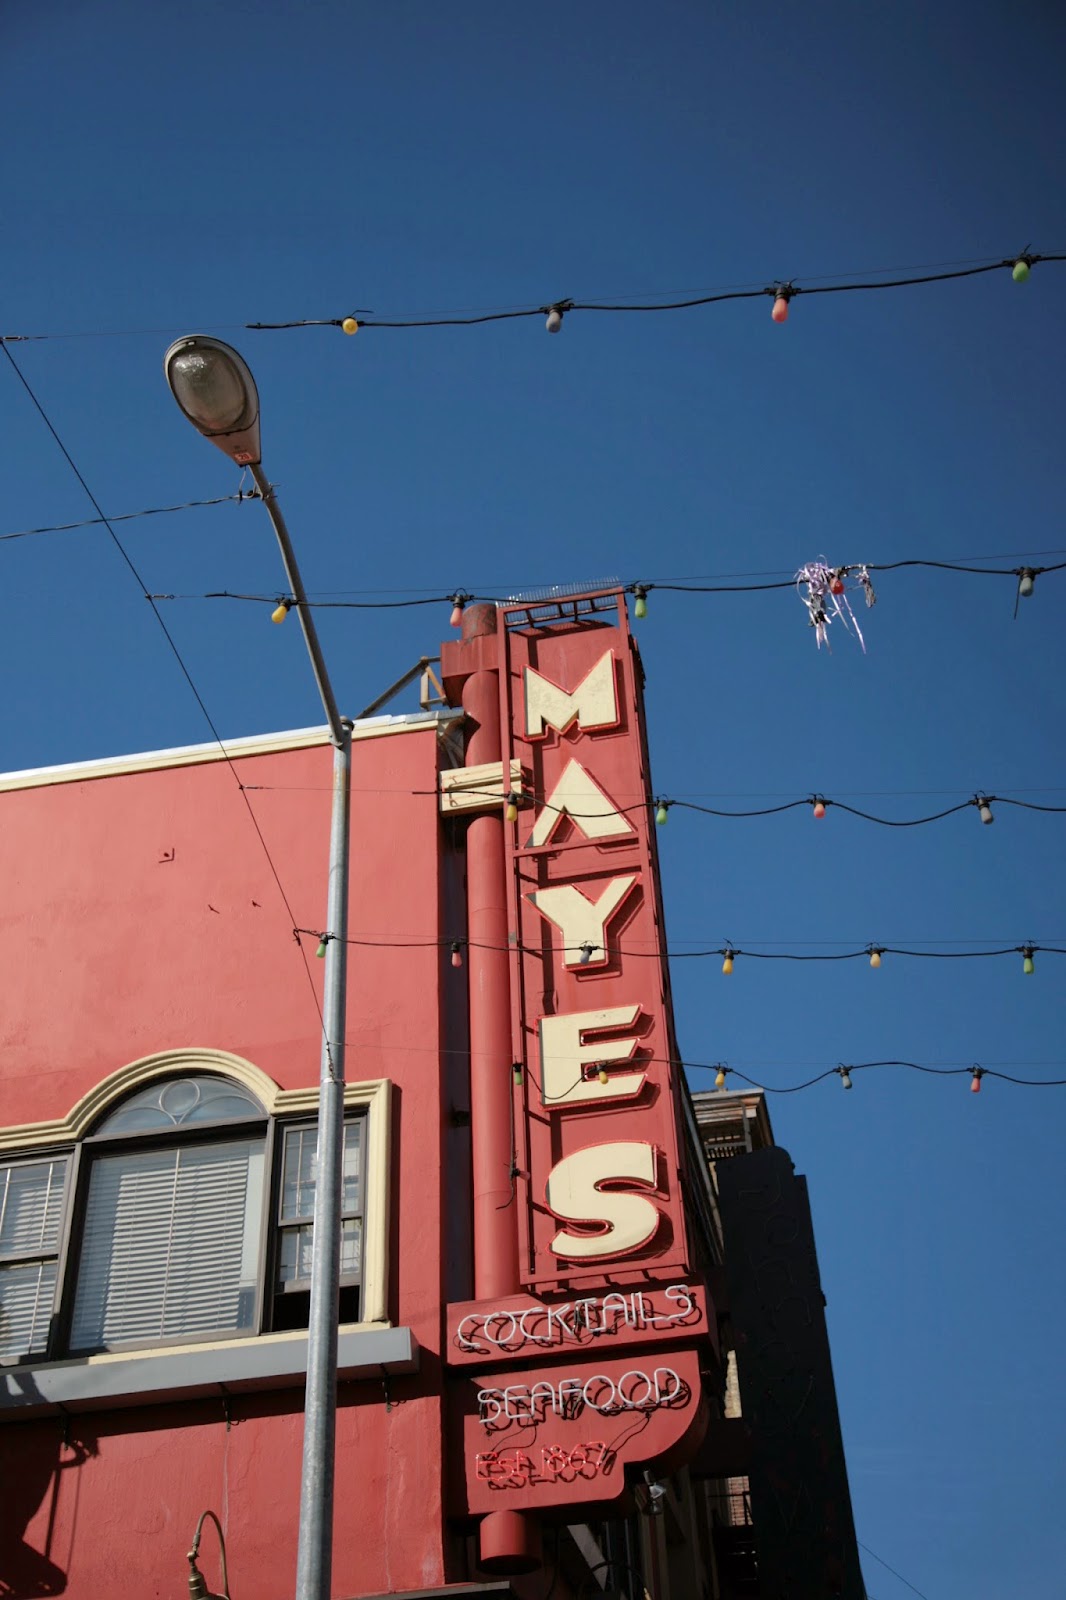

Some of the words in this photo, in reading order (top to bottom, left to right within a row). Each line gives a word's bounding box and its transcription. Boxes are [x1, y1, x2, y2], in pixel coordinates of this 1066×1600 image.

[522, 648, 660, 1263] MAYES
[458, 1284, 692, 1348] COCKTAILS
[477, 1367, 681, 1423] SEAFOOD
[541, 1441, 606, 1477] 1867
